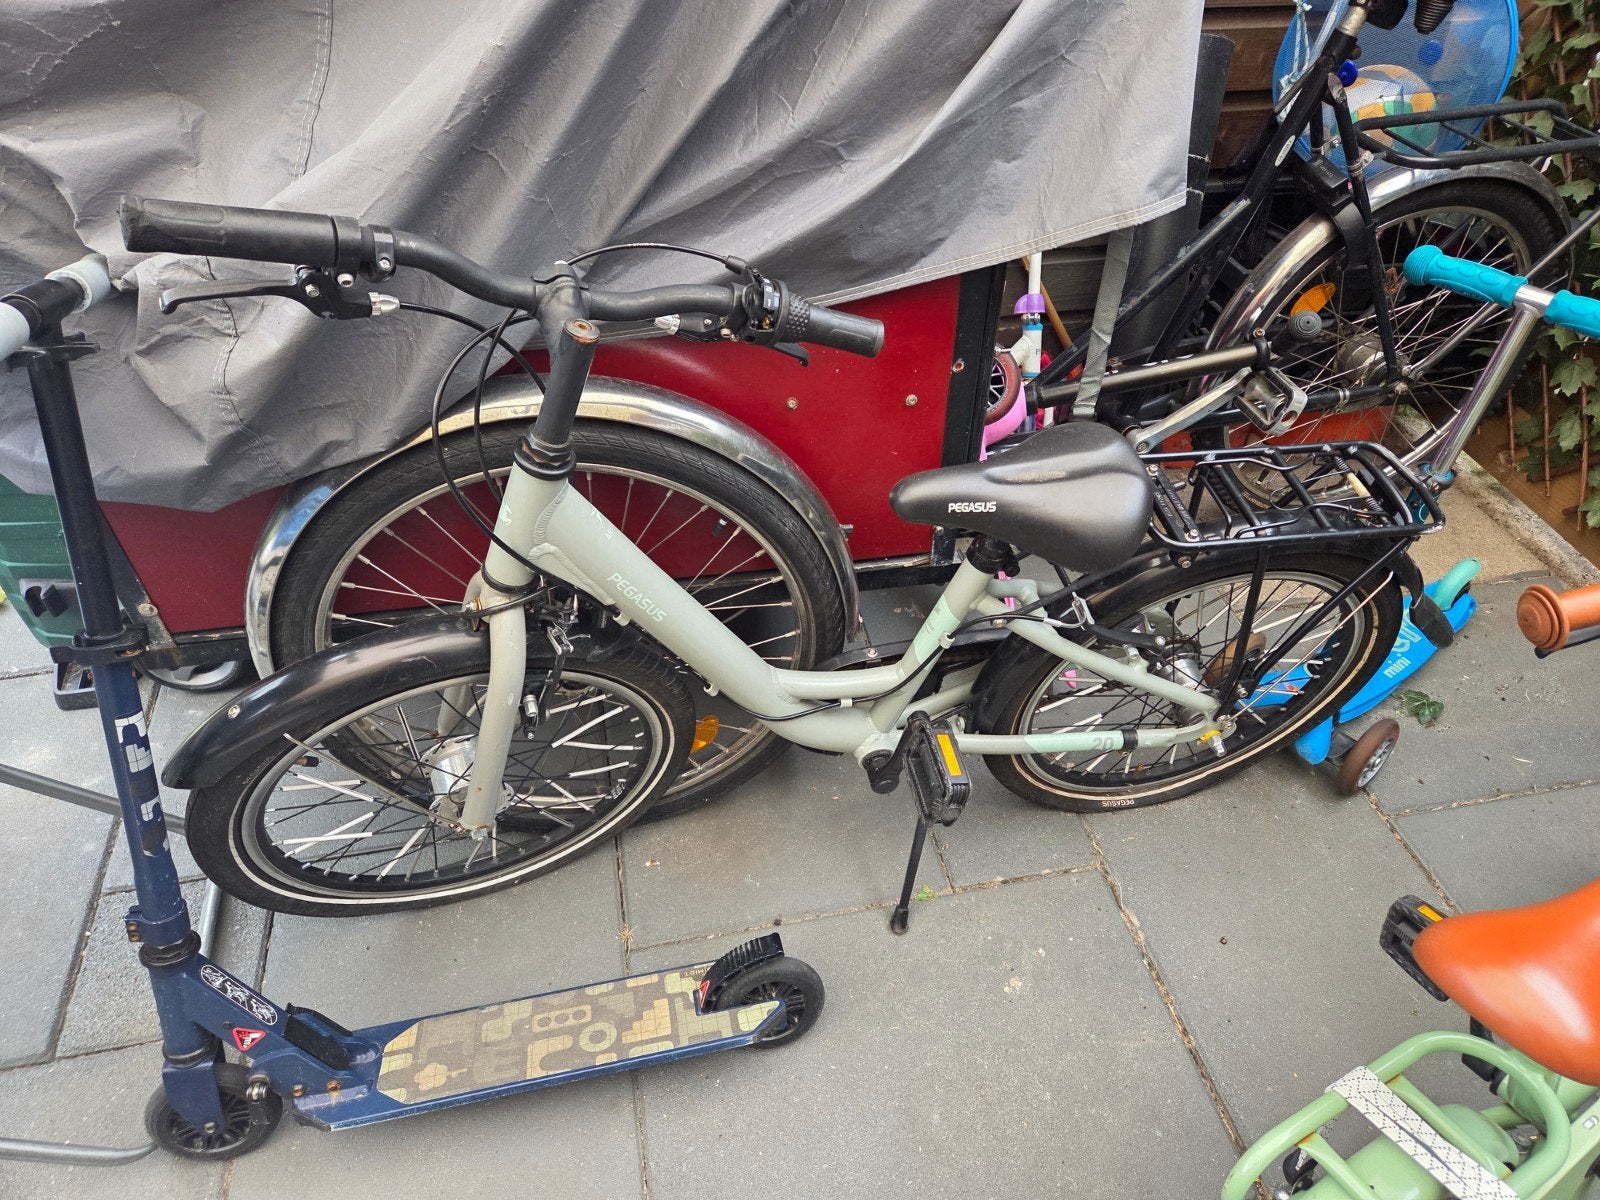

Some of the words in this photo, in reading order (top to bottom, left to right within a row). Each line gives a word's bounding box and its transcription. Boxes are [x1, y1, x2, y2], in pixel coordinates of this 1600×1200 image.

[948, 501, 997, 513] PEGASUS
[607, 572, 667, 623] PEGASUS
[1383, 653, 1412, 679] mini
[1091, 735, 1115, 750] 20
[1102, 799, 1135, 807] PEGASUS
